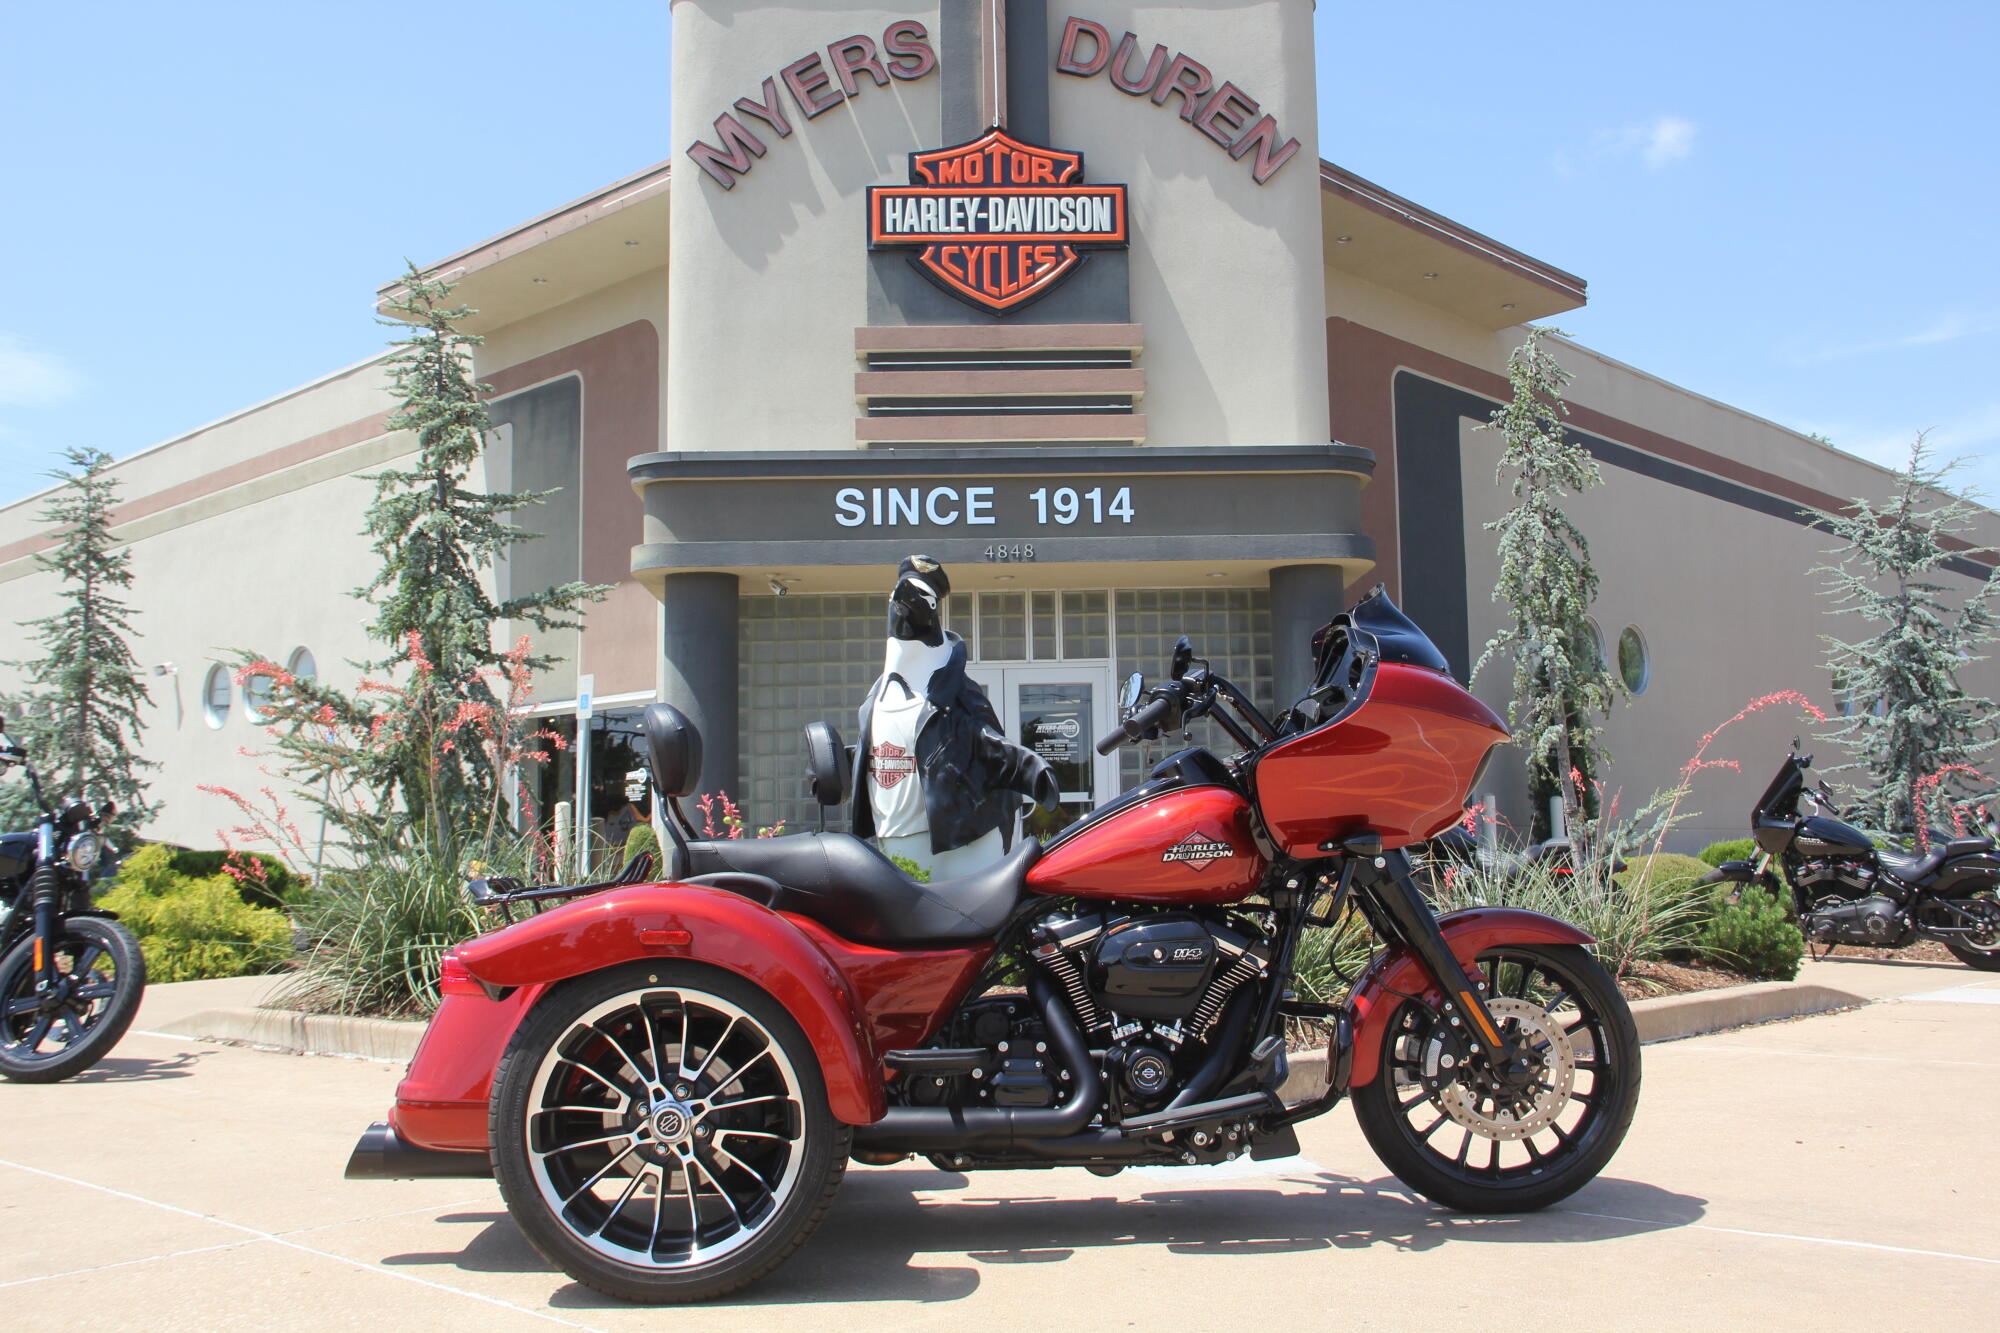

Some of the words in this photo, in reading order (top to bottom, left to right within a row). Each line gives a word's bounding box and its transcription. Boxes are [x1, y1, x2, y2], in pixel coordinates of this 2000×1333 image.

[686, 19, 938, 190] MYERS
[1055, 16, 1301, 185] DUREN
[938, 143, 1057, 184] MOTOR
[885, 196, 1111, 232] HARLEY-DAVIDSON
[941, 245, 1056, 297] CYCLES
[834, 486, 996, 527] SINCE
[1029, 487, 1135, 524] 1914
[984, 544, 1034, 559] 4848
[1162, 850, 1234, 862] DAVIDSON
